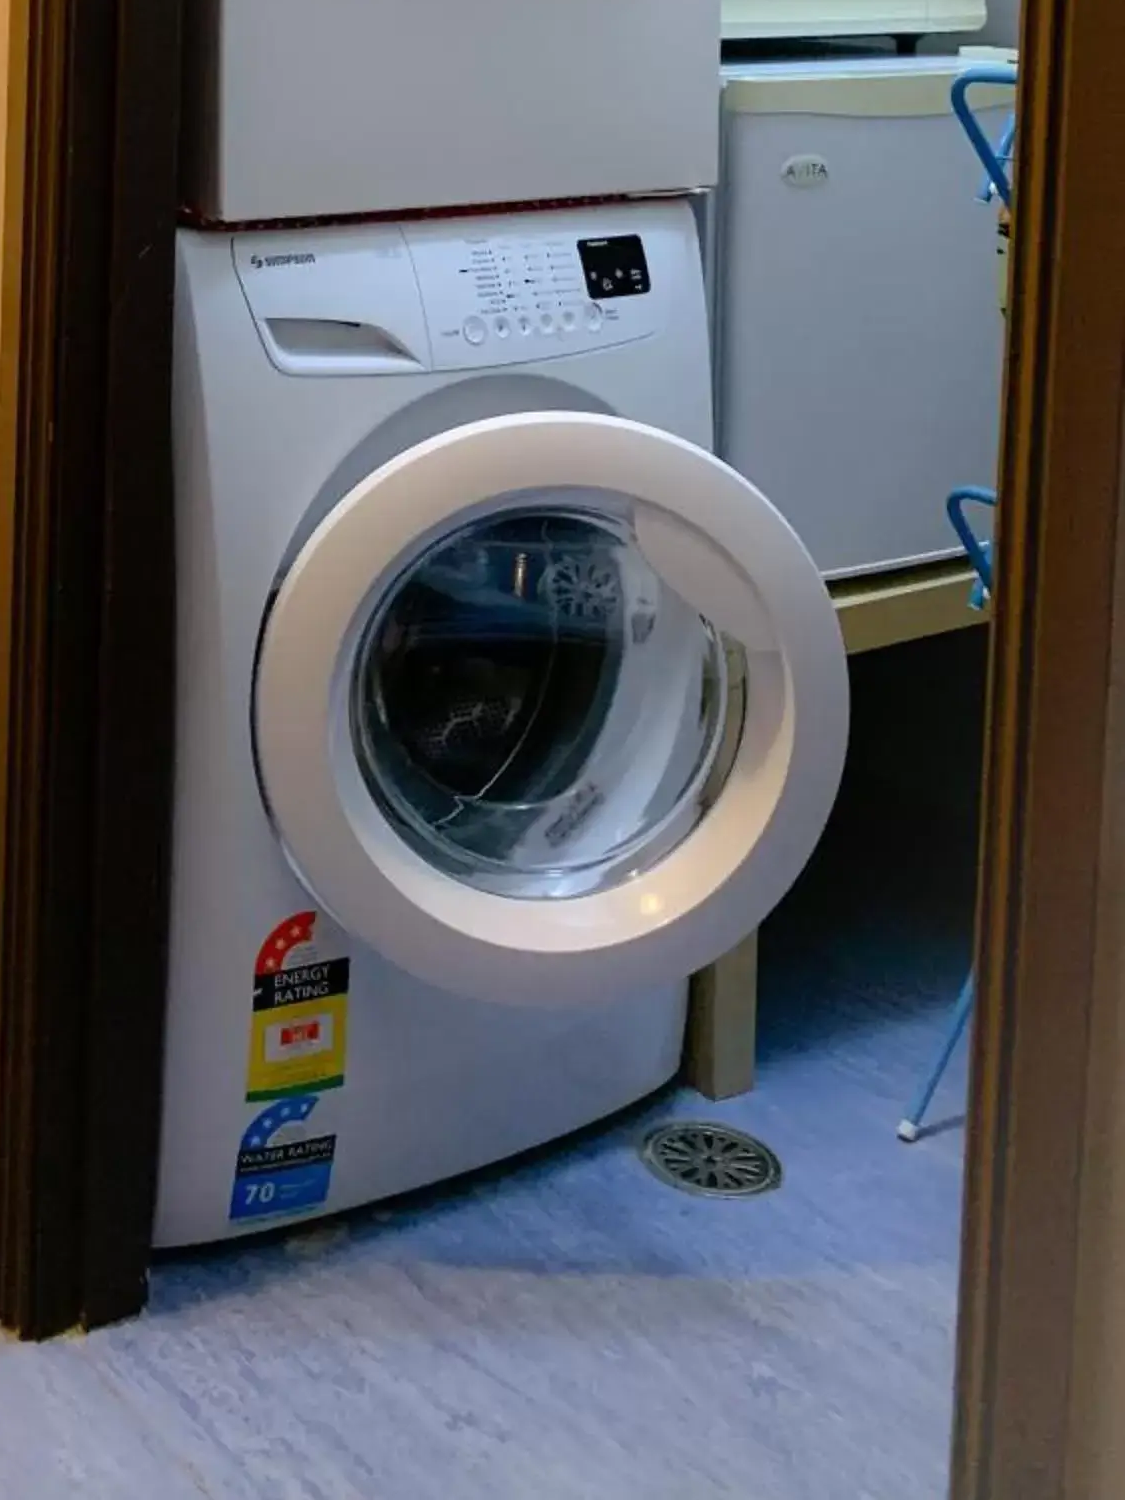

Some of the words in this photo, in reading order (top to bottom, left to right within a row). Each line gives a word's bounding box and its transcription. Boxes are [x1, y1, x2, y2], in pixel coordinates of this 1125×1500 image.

[275, 964, 330, 988] ENERGY
[275, 982, 329, 1005] RATING
[245, 1181, 275, 1205] 70
